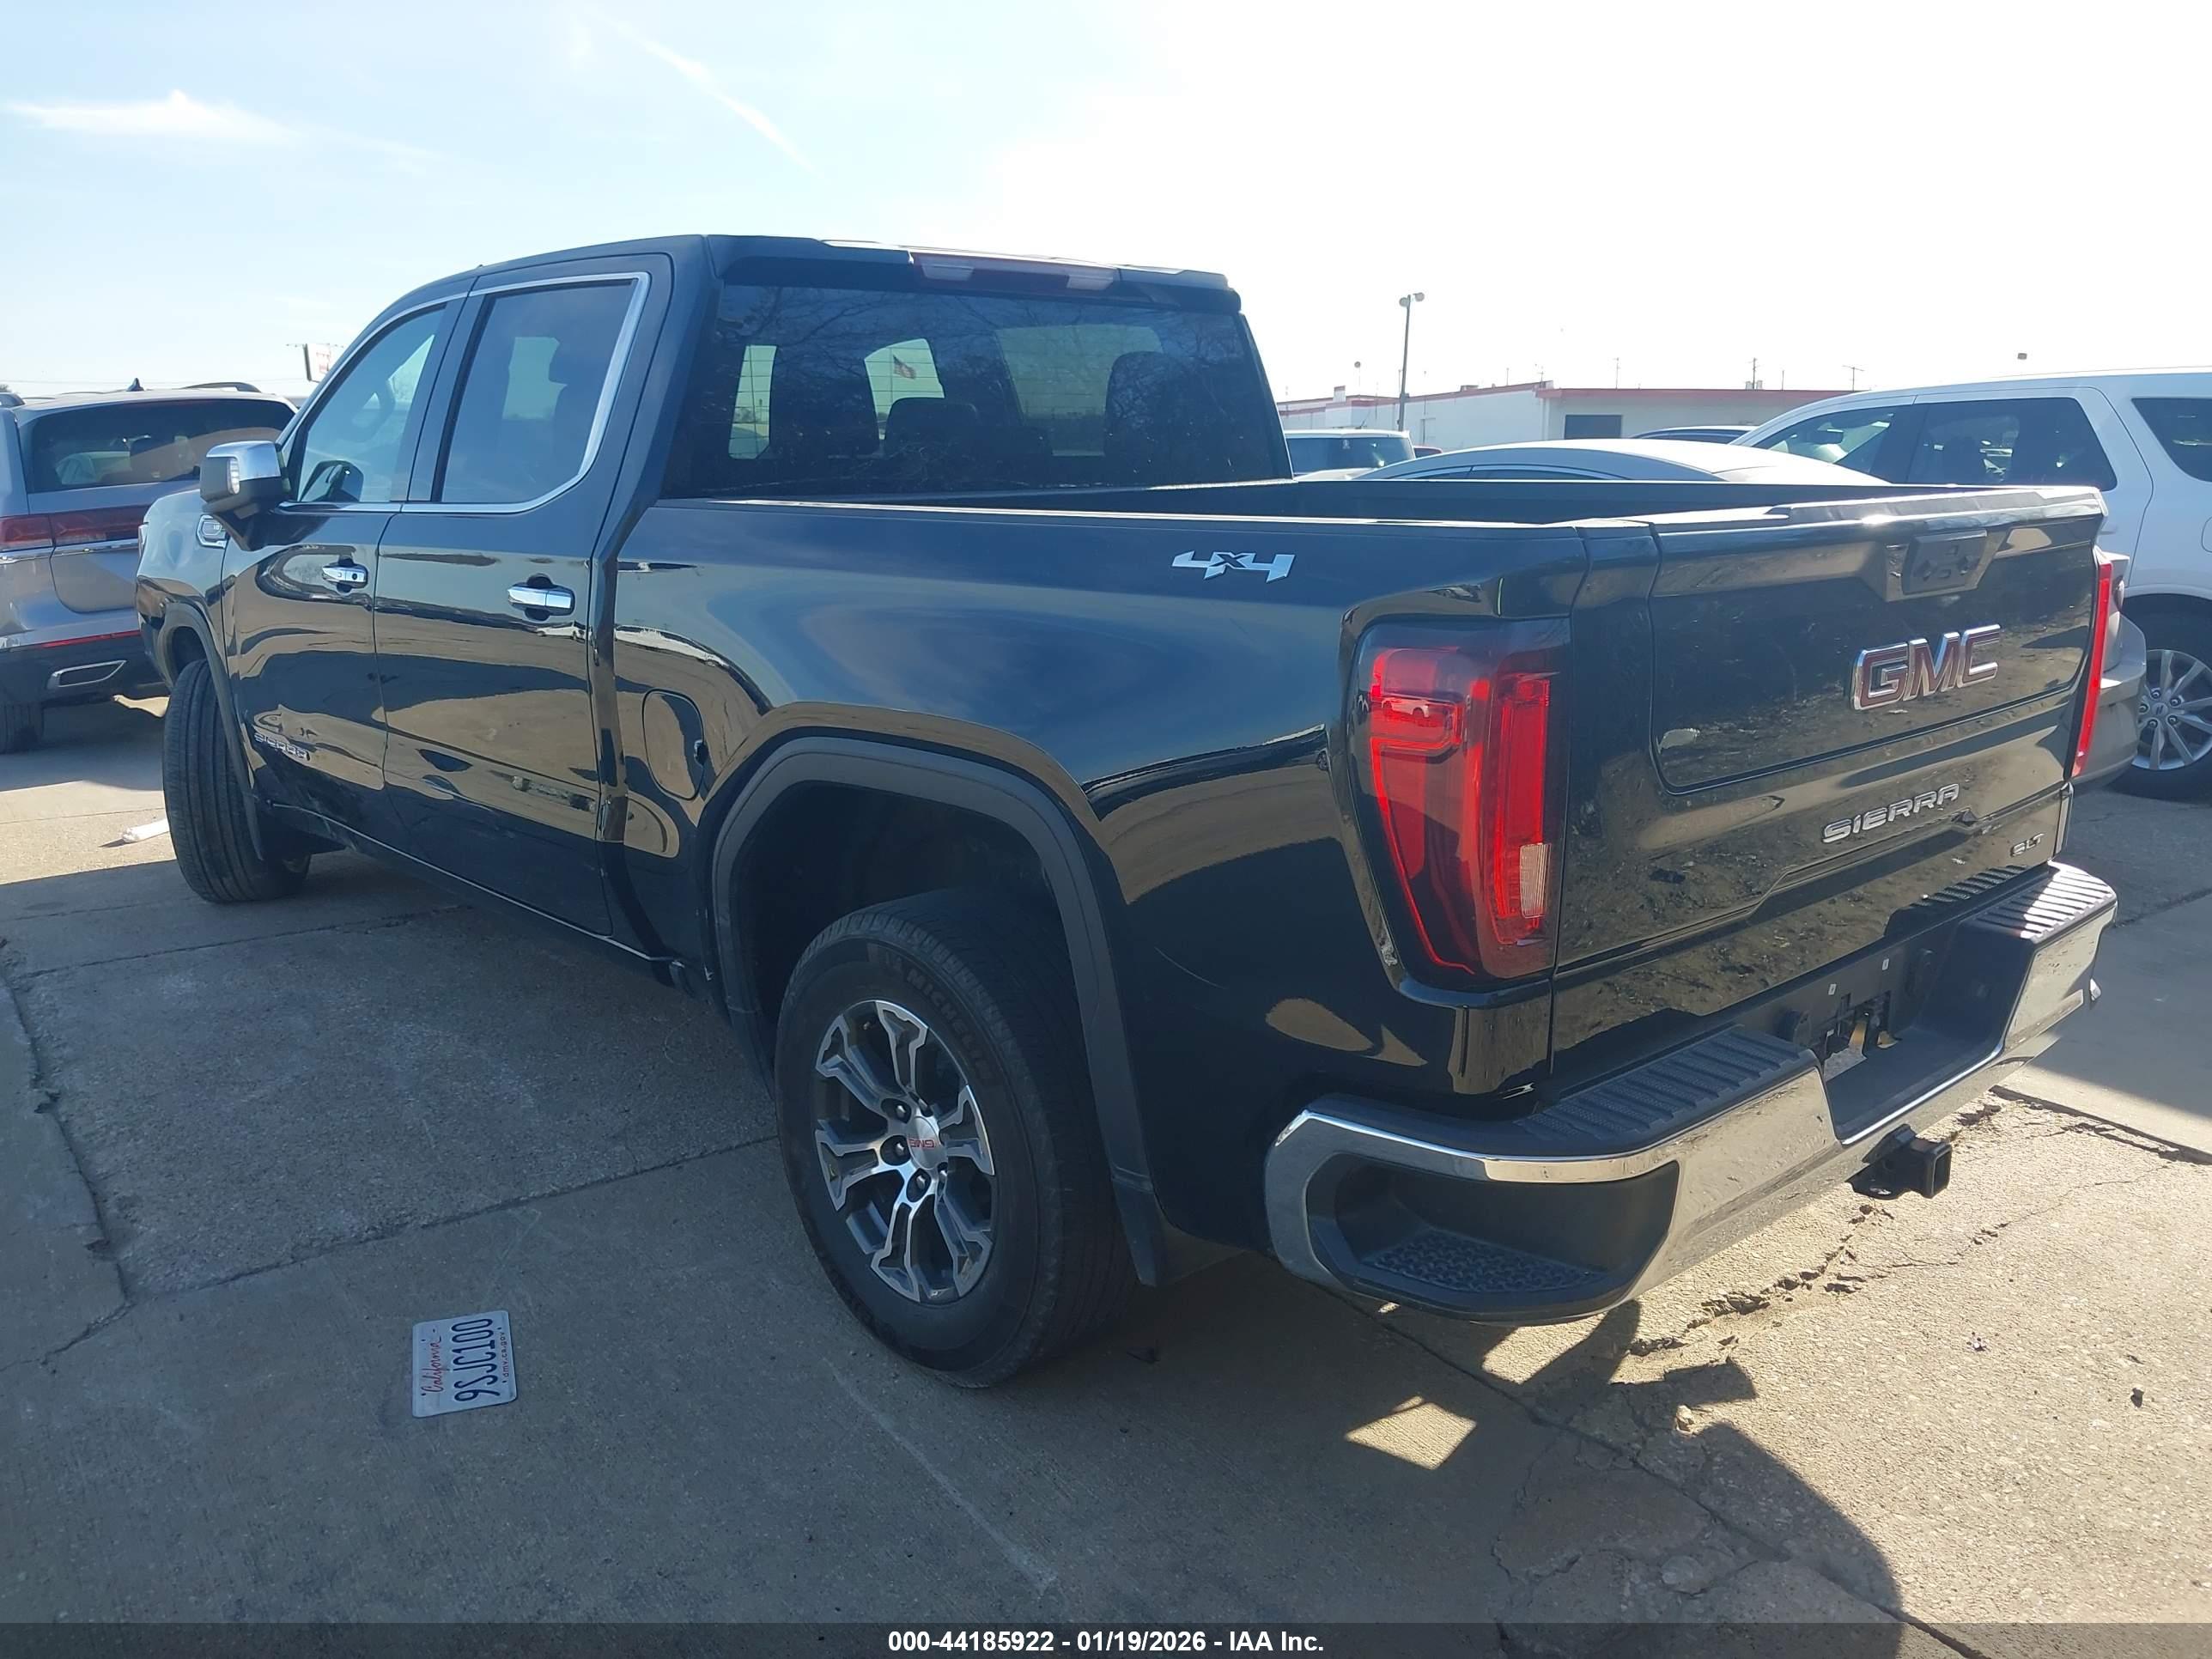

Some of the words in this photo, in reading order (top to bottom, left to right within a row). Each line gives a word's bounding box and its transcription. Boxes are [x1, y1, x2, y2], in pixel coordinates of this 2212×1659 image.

[1850, 623, 2002, 711] GMC
[1820, 782, 1960, 844] SIERRA
[2008, 832, 2045, 857] SLT
[907, 1138, 935, 1149] GMC
[421, 1334, 451, 1393] California
[451, 1318, 501, 1402] 9SJC100
